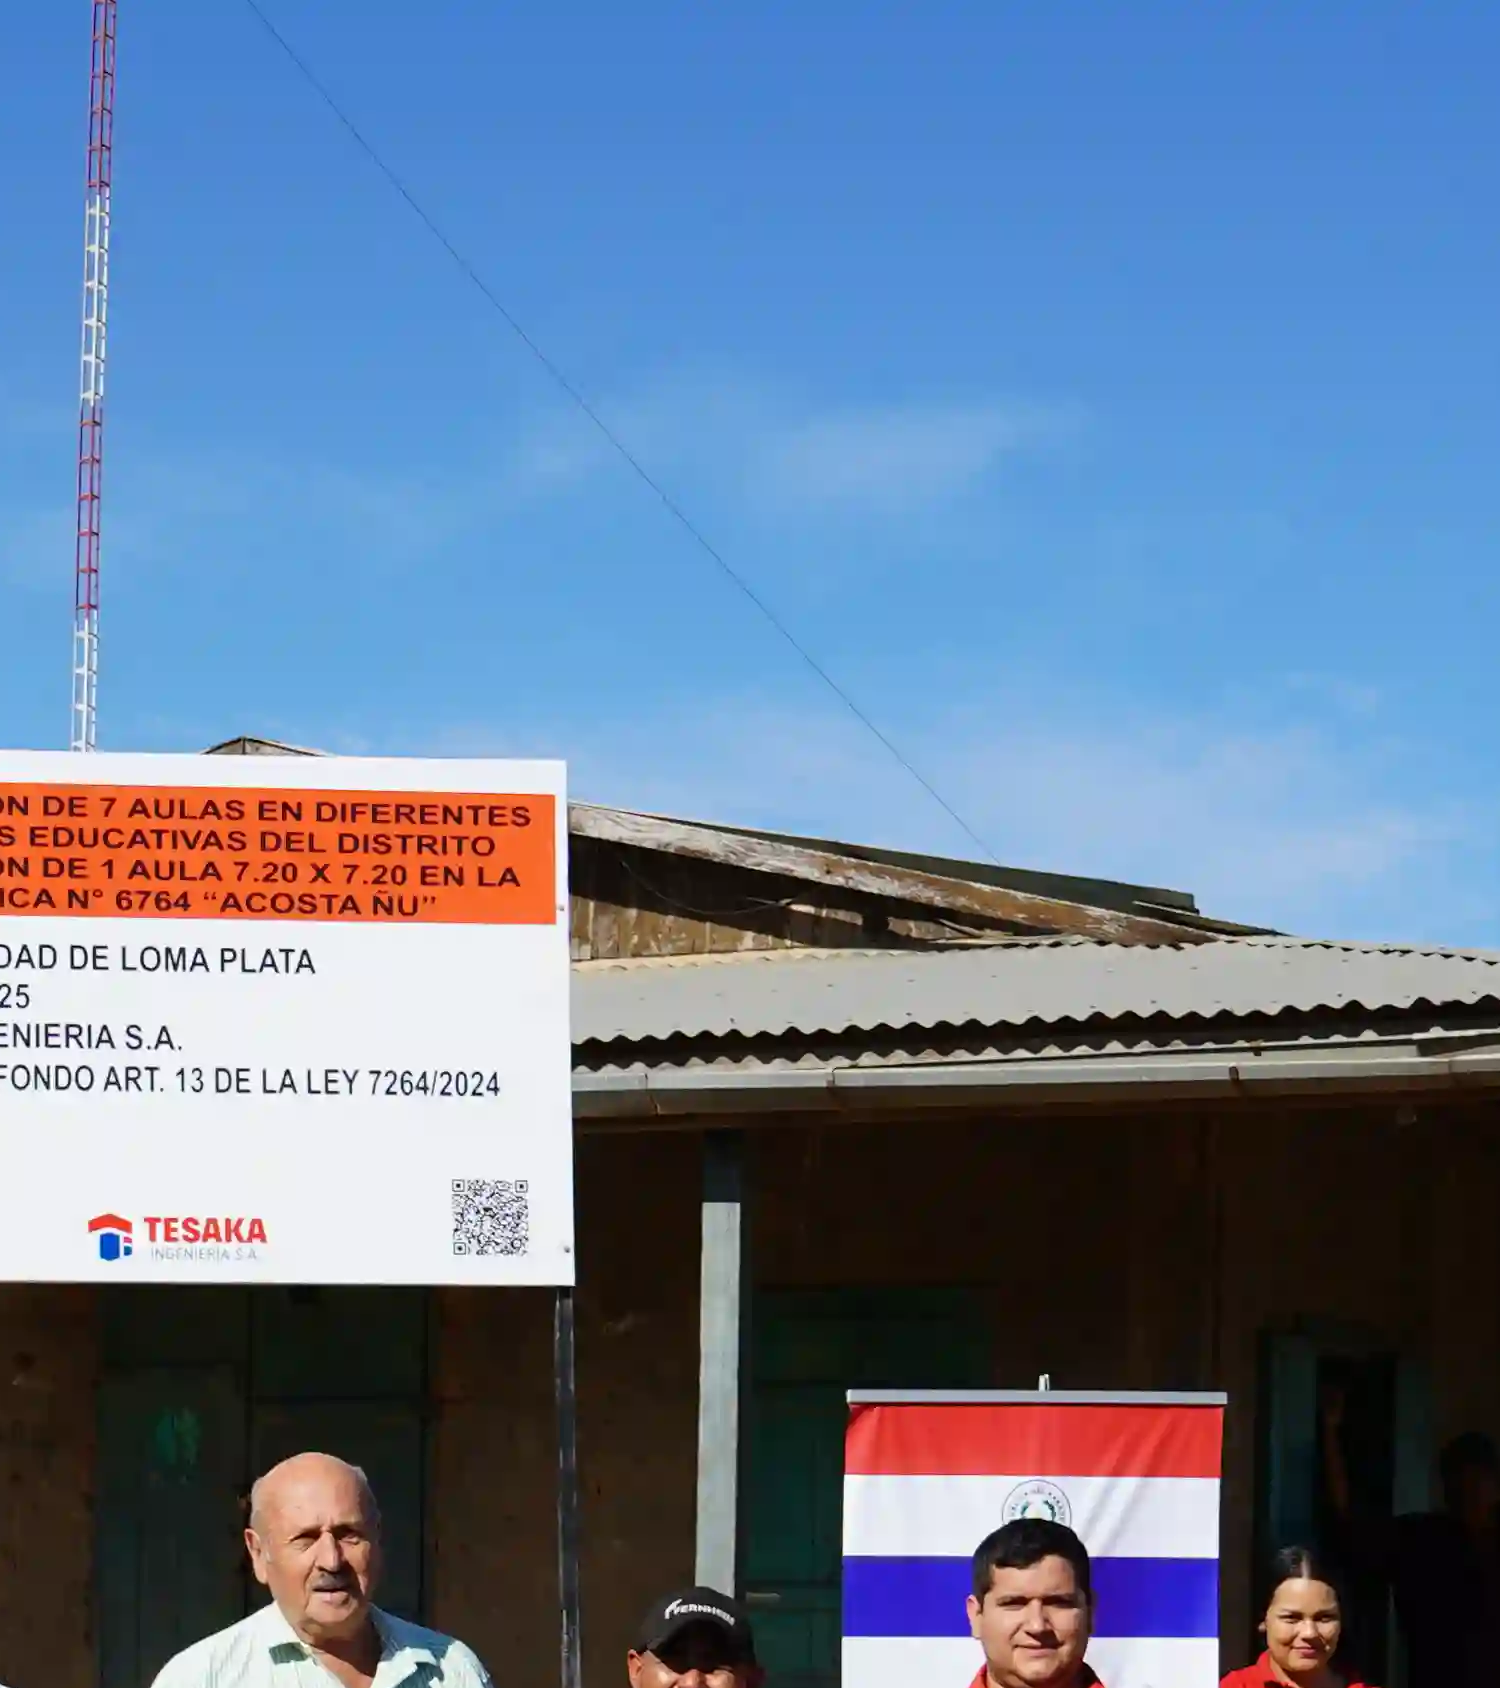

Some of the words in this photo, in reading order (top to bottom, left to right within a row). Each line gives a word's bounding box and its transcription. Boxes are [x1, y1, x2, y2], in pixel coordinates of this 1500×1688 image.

[43, 796, 87, 817] DE
[99, 798, 116, 817] 7
[128, 798, 245, 821] AULAS
[258, 800, 302, 822] EN
[315, 802, 531, 827] DIFERENTES
[29, 826, 247, 852] EDUCATIVAS
[260, 831, 326, 853] DEL
[338, 833, 495, 856] DISTRITO
[42, 857, 86, 879] DE
[102, 859, 113, 879] 1
[128, 859, 222, 881] AULA
[234, 862, 298, 883] 7.20
[311, 863, 330, 883] X
[343, 864, 407, 886] 7.20
[420, 865, 464, 887] EN
[478, 867, 521, 887] LA
[115, 890, 191, 912] 6764
[69, 944, 109, 971] DE
[121, 945, 210, 973] LOMA
[220, 947, 316, 975] PLATA
[125, 1024, 182, 1051] S.A.
[103, 1065, 164, 1093] ART.
[175, 1067, 204, 1093] 13
[215, 1067, 251, 1094] DE
[262, 1068, 298, 1094] LA
[307, 1068, 359, 1095] LEY
[368, 1069, 500, 1097] 7264/2024
[143, 1216, 268, 1244] TESAKA
